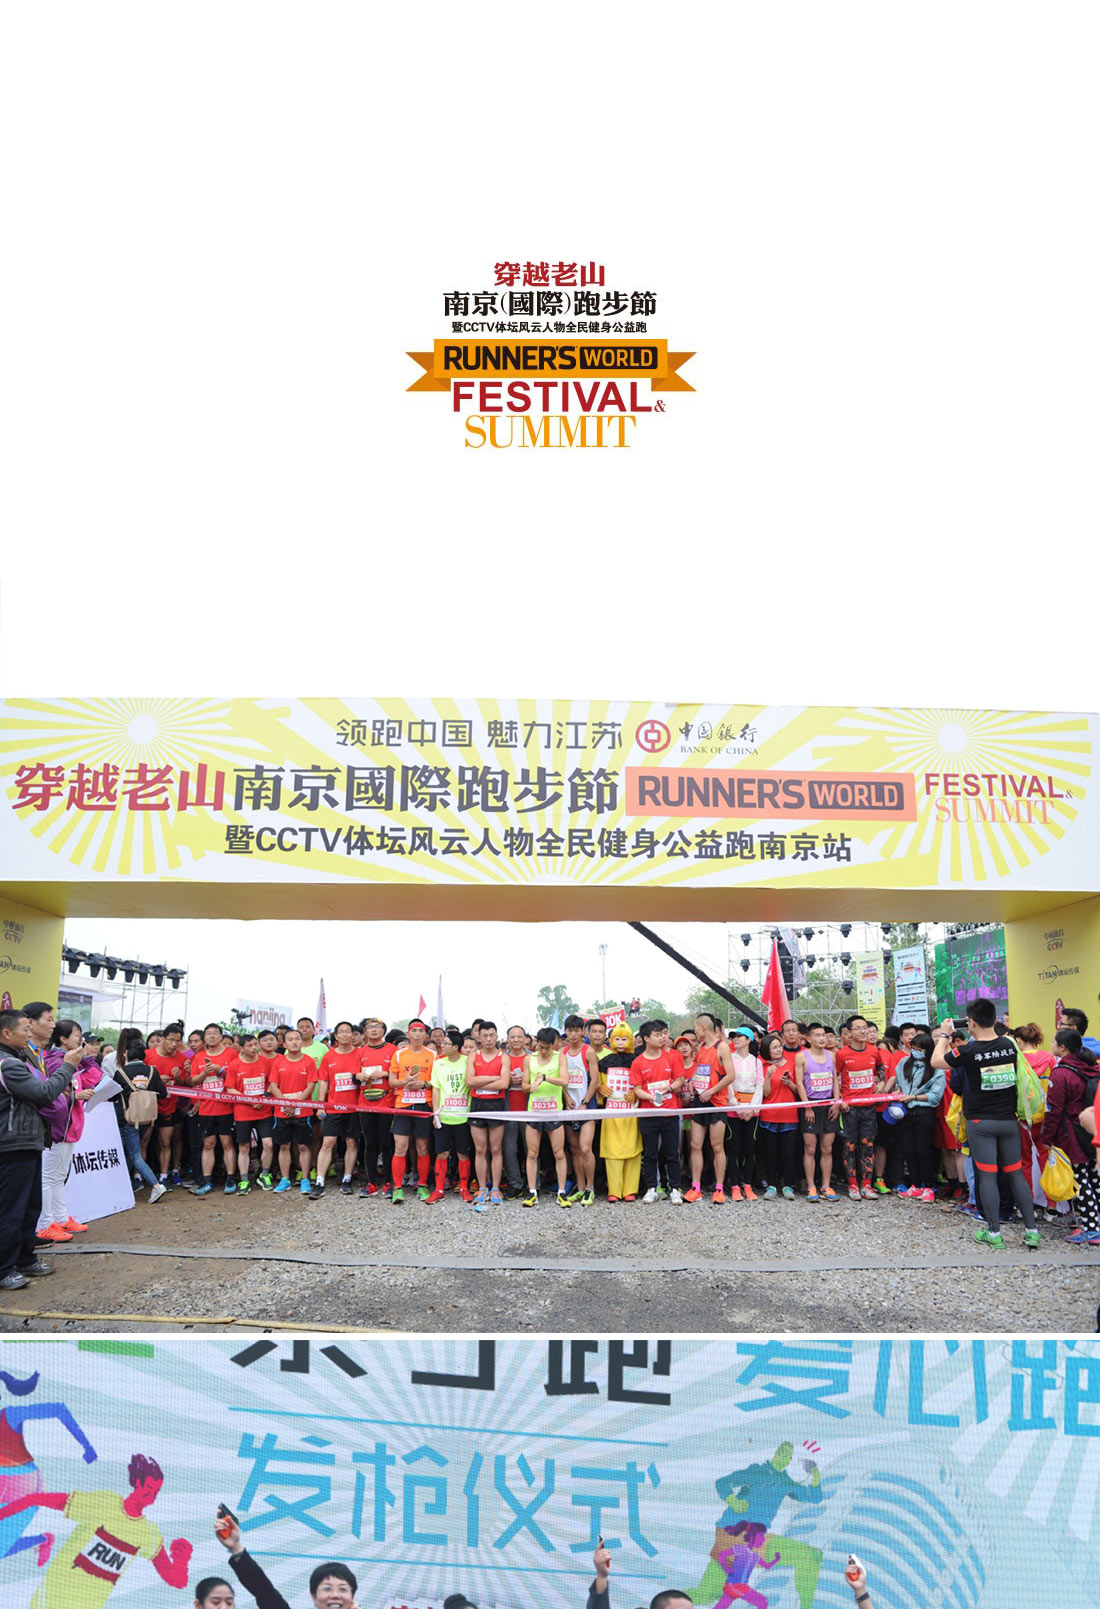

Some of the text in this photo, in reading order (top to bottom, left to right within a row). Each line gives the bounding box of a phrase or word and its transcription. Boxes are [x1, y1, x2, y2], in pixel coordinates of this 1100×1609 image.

[494, 262, 605, 287] 穿越老山
[452, 321, 647, 334] 暨CCTV体坛风云人物全民健身公益跑
[444, 345, 653, 371] RUNNER'S WORLD
[453, 381, 667, 412] FESTIVAL &
[465, 415, 636, 448] SUMMIT
[336, 719, 759, 750] 领跑中国 魅力江苏 中国银行
[680, 745, 759, 756] BANK OF CHINA
[638, 775, 806, 809] RUNNER'S
[813, 782, 899, 807] WORLD
[925, 773, 1063, 799] FESTIVAL
[936, 798, 1054, 825] SUMMIT
[225, 824, 852, 862] 暨CCTV体坛风云人物全民健身公益跑南京站
[604, 1012, 621, 1029] 10K
[403, 1090, 426, 1098] 31003
[445, 1099, 467, 1107] 31002
[532, 1101, 557, 1109] 30234
[72, 1148, 120, 1175] 体坛传媒
[238, 1432, 660, 1557] 发枪仪式
[88, 1542, 126, 1572] RUN
